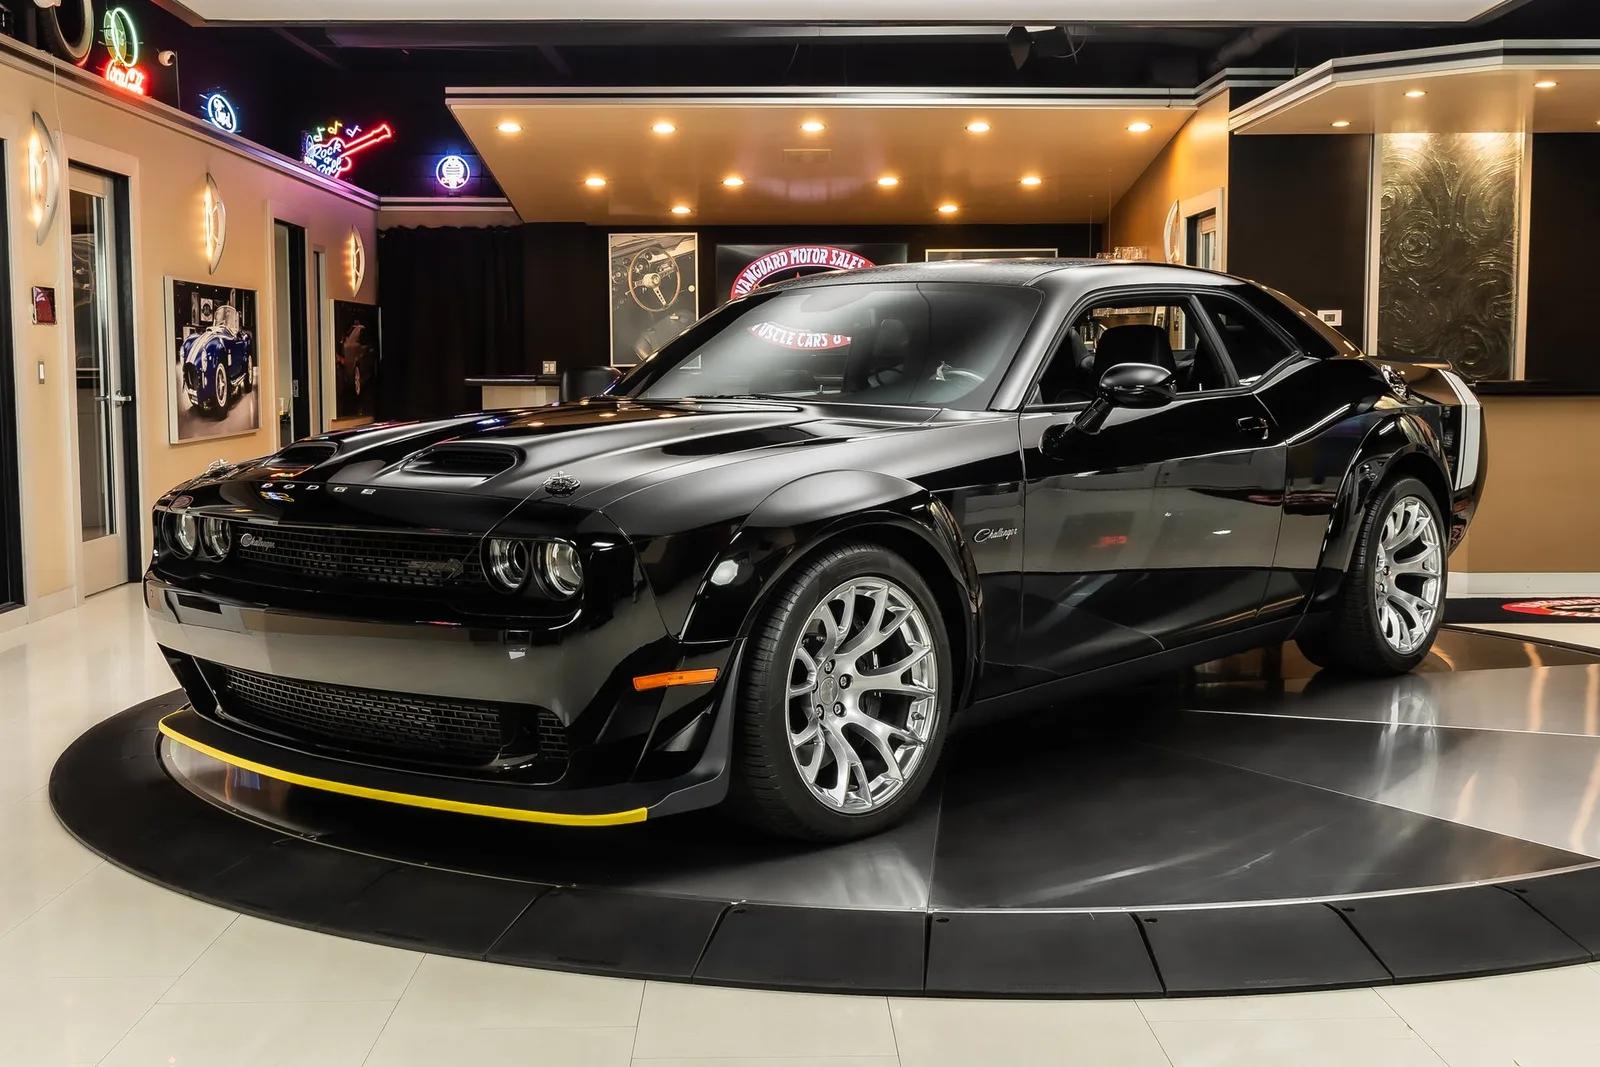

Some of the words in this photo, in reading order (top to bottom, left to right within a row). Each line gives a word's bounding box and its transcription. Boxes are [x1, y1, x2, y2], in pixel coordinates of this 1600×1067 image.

[313, 139, 342, 160] Rock
[735, 251, 788, 295] VANGUARD
[789, 247, 828, 265] MOTOR
[797, 333, 828, 348] CARS
[260, 482, 377, 495] DODGE
